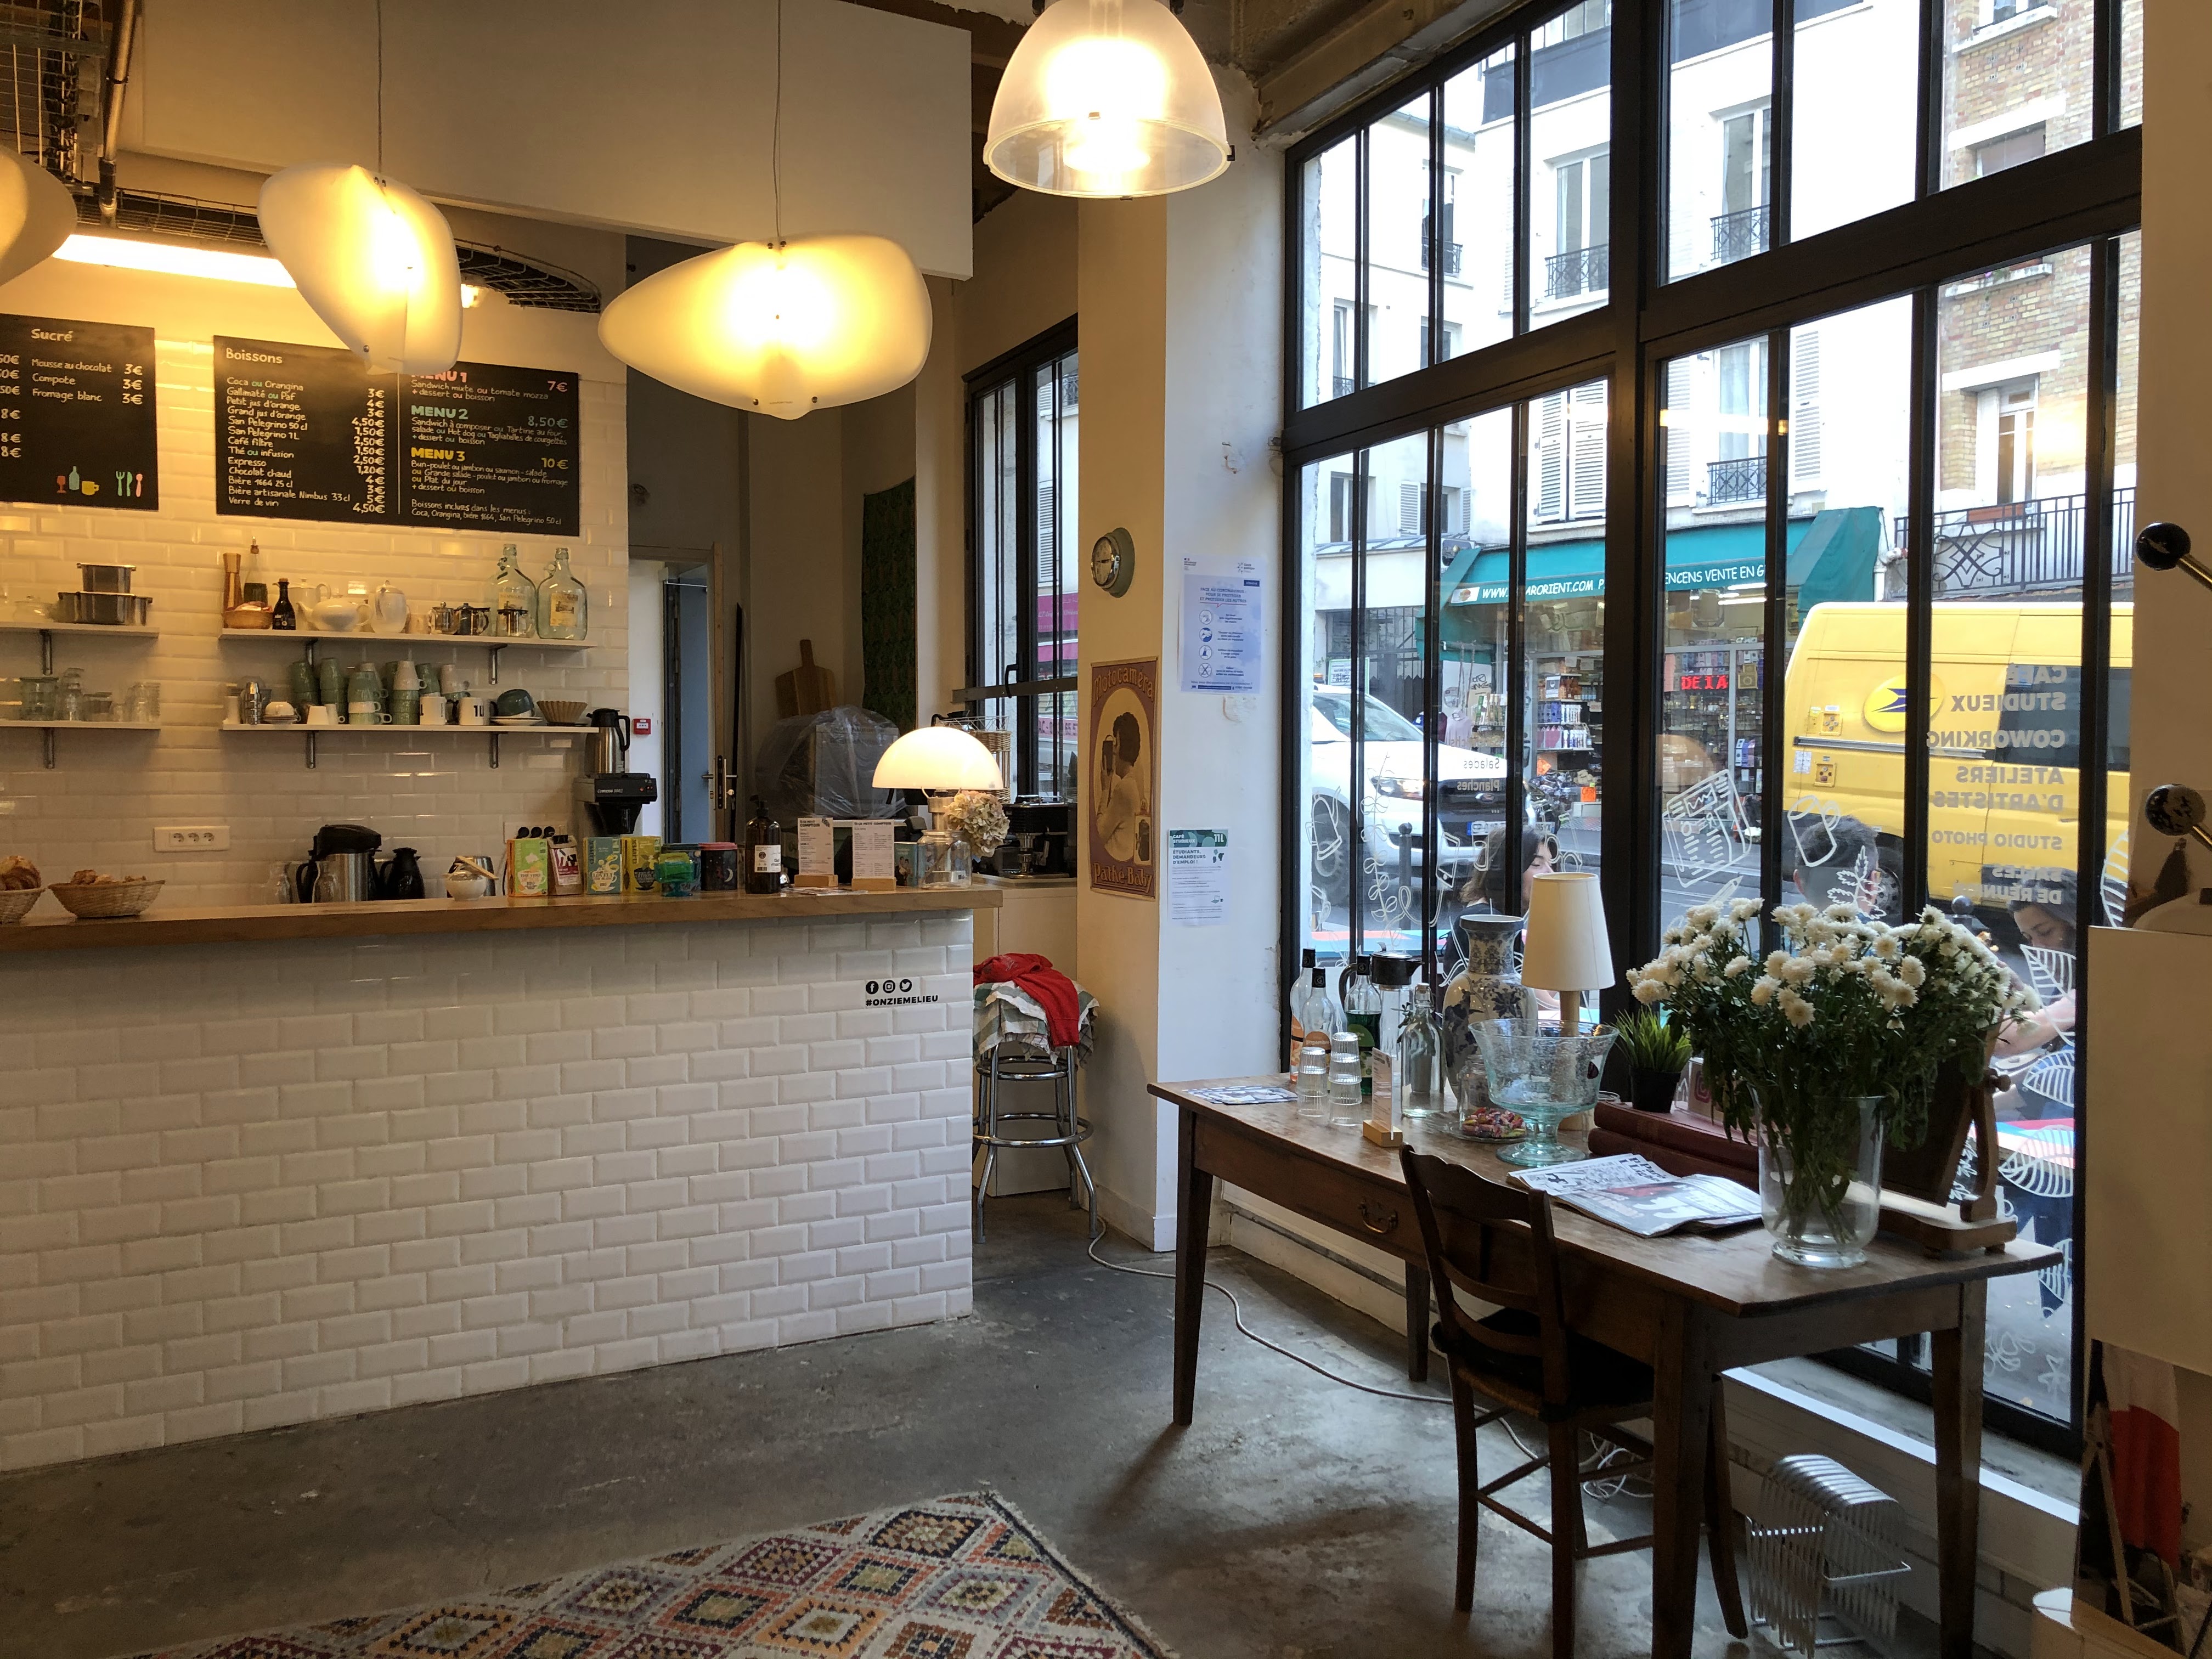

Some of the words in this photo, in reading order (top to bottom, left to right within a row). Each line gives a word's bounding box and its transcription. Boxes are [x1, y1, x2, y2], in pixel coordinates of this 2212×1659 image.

[31, 329, 73, 342] Sucré
[226, 347, 283, 364] Boissons
[31, 358, 63, 369] Mousse
[75, 361, 112, 372] chocolat
[124, 363, 143, 375] 3€
[32, 373, 76, 386] Compote
[122, 379, 142, 390] 3€
[227, 377, 249, 386] Coca
[264, 380, 304, 393] Orangina
[368, 388, 385, 398] 3€
[411, 380, 449, 390] Sandwich
[490, 387, 521, 397] tomate
[460, 372, 467, 383] 1
[548, 380, 568, 392] 7€
[32, 388, 74, 403] Fromage
[77, 391, 103, 402] blanc
[122, 393, 143, 405] 3€
[366, 399, 385, 408] 4€
[1, 408, 21, 420] 8€
[227, 396, 247, 405] Petit
[247, 399, 261, 409] jus
[264, 400, 301, 412] d'orange
[367, 408, 385, 418] 3€
[227, 405, 254, 416] Grand
[255, 410, 268, 419] jus
[270, 410, 307, 422] d'orange
[351, 417, 385, 428] 4,50€
[411, 405, 456, 418] MENU
[458, 408, 469, 420] 2
[528, 415, 568, 428] 8,50€
[228, 415, 245, 425] San
[248, 417, 287, 430] Pelegrino
[300, 422, 308, 431] cl
[354, 426, 385, 437] 1,50€
[411, 416, 448, 427] Sandwich
[449, 420, 454, 428] à
[507, 426, 534, 435] Tartine
[1, 432, 21, 443] 8€
[228, 426, 246, 435] San
[247, 427, 287, 440] Pelegrino
[288, 432, 300, 440] 1L
[353, 436, 385, 447] 2,50€
[462, 430, 475, 439] dog
[1, 445, 21, 458] 8€
[228, 436, 249, 445] Café
[356, 446, 385, 456] 1,50€
[411, 447, 454, 460] MENU
[456, 451, 465, 461] 3
[228, 446, 245, 455] Thé
[261, 449, 295, 459] infusion
[353, 455, 385, 465] 2,50€
[228, 456, 267, 468] Expresso
[356, 465, 385, 475] 1,20€
[461, 463, 484, 472] jambon
[525, 469, 548, 477] salade
[229, 467, 264, 476] Chocolat
[267, 469, 292, 478] chaud
[365, 475, 385, 485] 4€
[424, 469, 450, 477] Grande
[507, 475, 531, 483] jambon
[541, 477, 568, 488] fromage
[228, 476, 252, 486] Bière
[286, 480, 293, 488] cl
[367, 484, 385, 494] 3€
[228, 485, 252, 495] Bière
[253, 488, 297, 499] artisanale
[299, 490, 328, 501] Nimbus
[366, 494, 385, 504] 5€
[228, 496, 251, 505] Verre
[254, 498, 264, 506] de
[352, 503, 385, 514] 4,50€
[411, 499, 442, 509] Boissons
[444, 503, 470, 511] incluses
[490, 504, 500, 513] les
[1705, 567, 1737, 582] VENTE
[1740, 566, 1754, 578] EN
[1681, 676, 1702, 690] DE
[865, 995, 938, 1007] #ONZIEMELIEU
